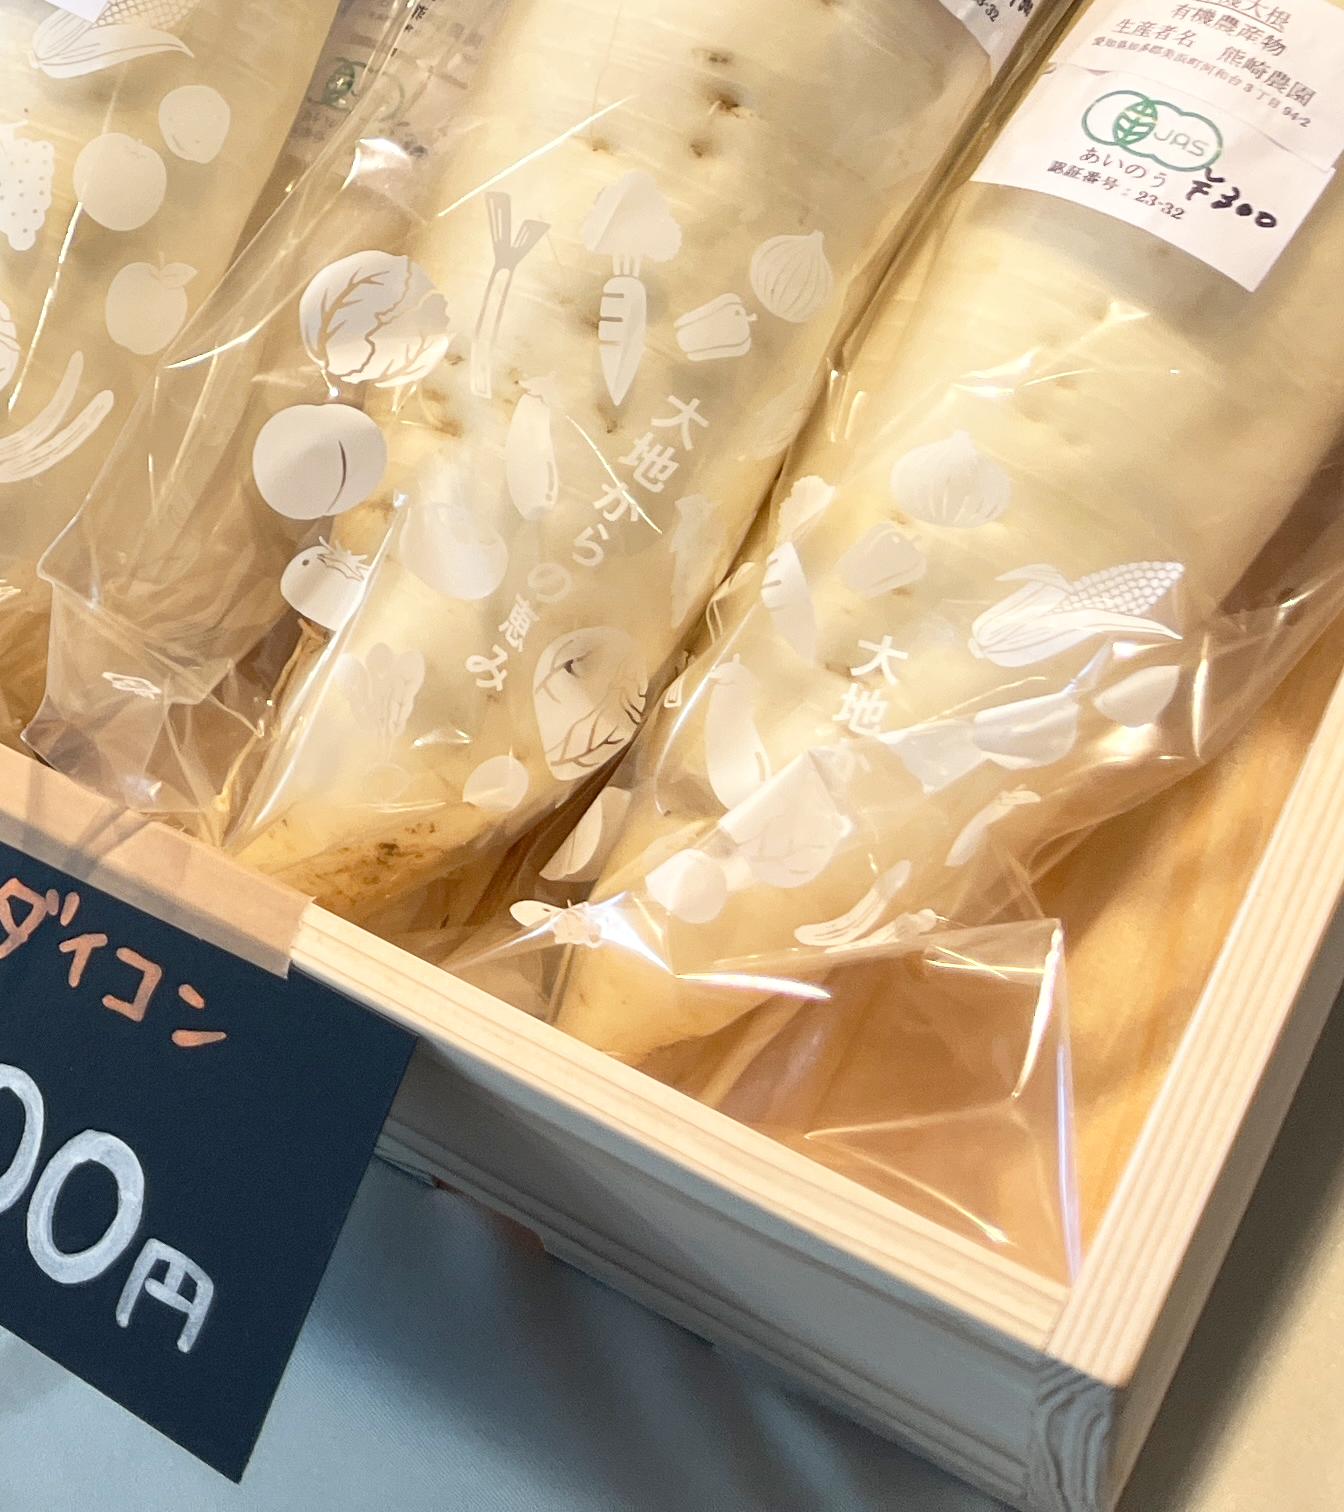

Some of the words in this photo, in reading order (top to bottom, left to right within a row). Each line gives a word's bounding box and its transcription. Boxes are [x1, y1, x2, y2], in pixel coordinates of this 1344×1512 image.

[1170, 2, 1288, 57] 有機農産物
[1111, 17, 1200, 49] 生産者名
[1216, 45, 1318, 108] 熊崎農園
[1078, 146, 1169, 188] あいのう
[1152, 129, 1211, 158] JAS
[1185, 166, 1278, 229] ¥300
[464, 393, 710, 693] 大地からの恵み
